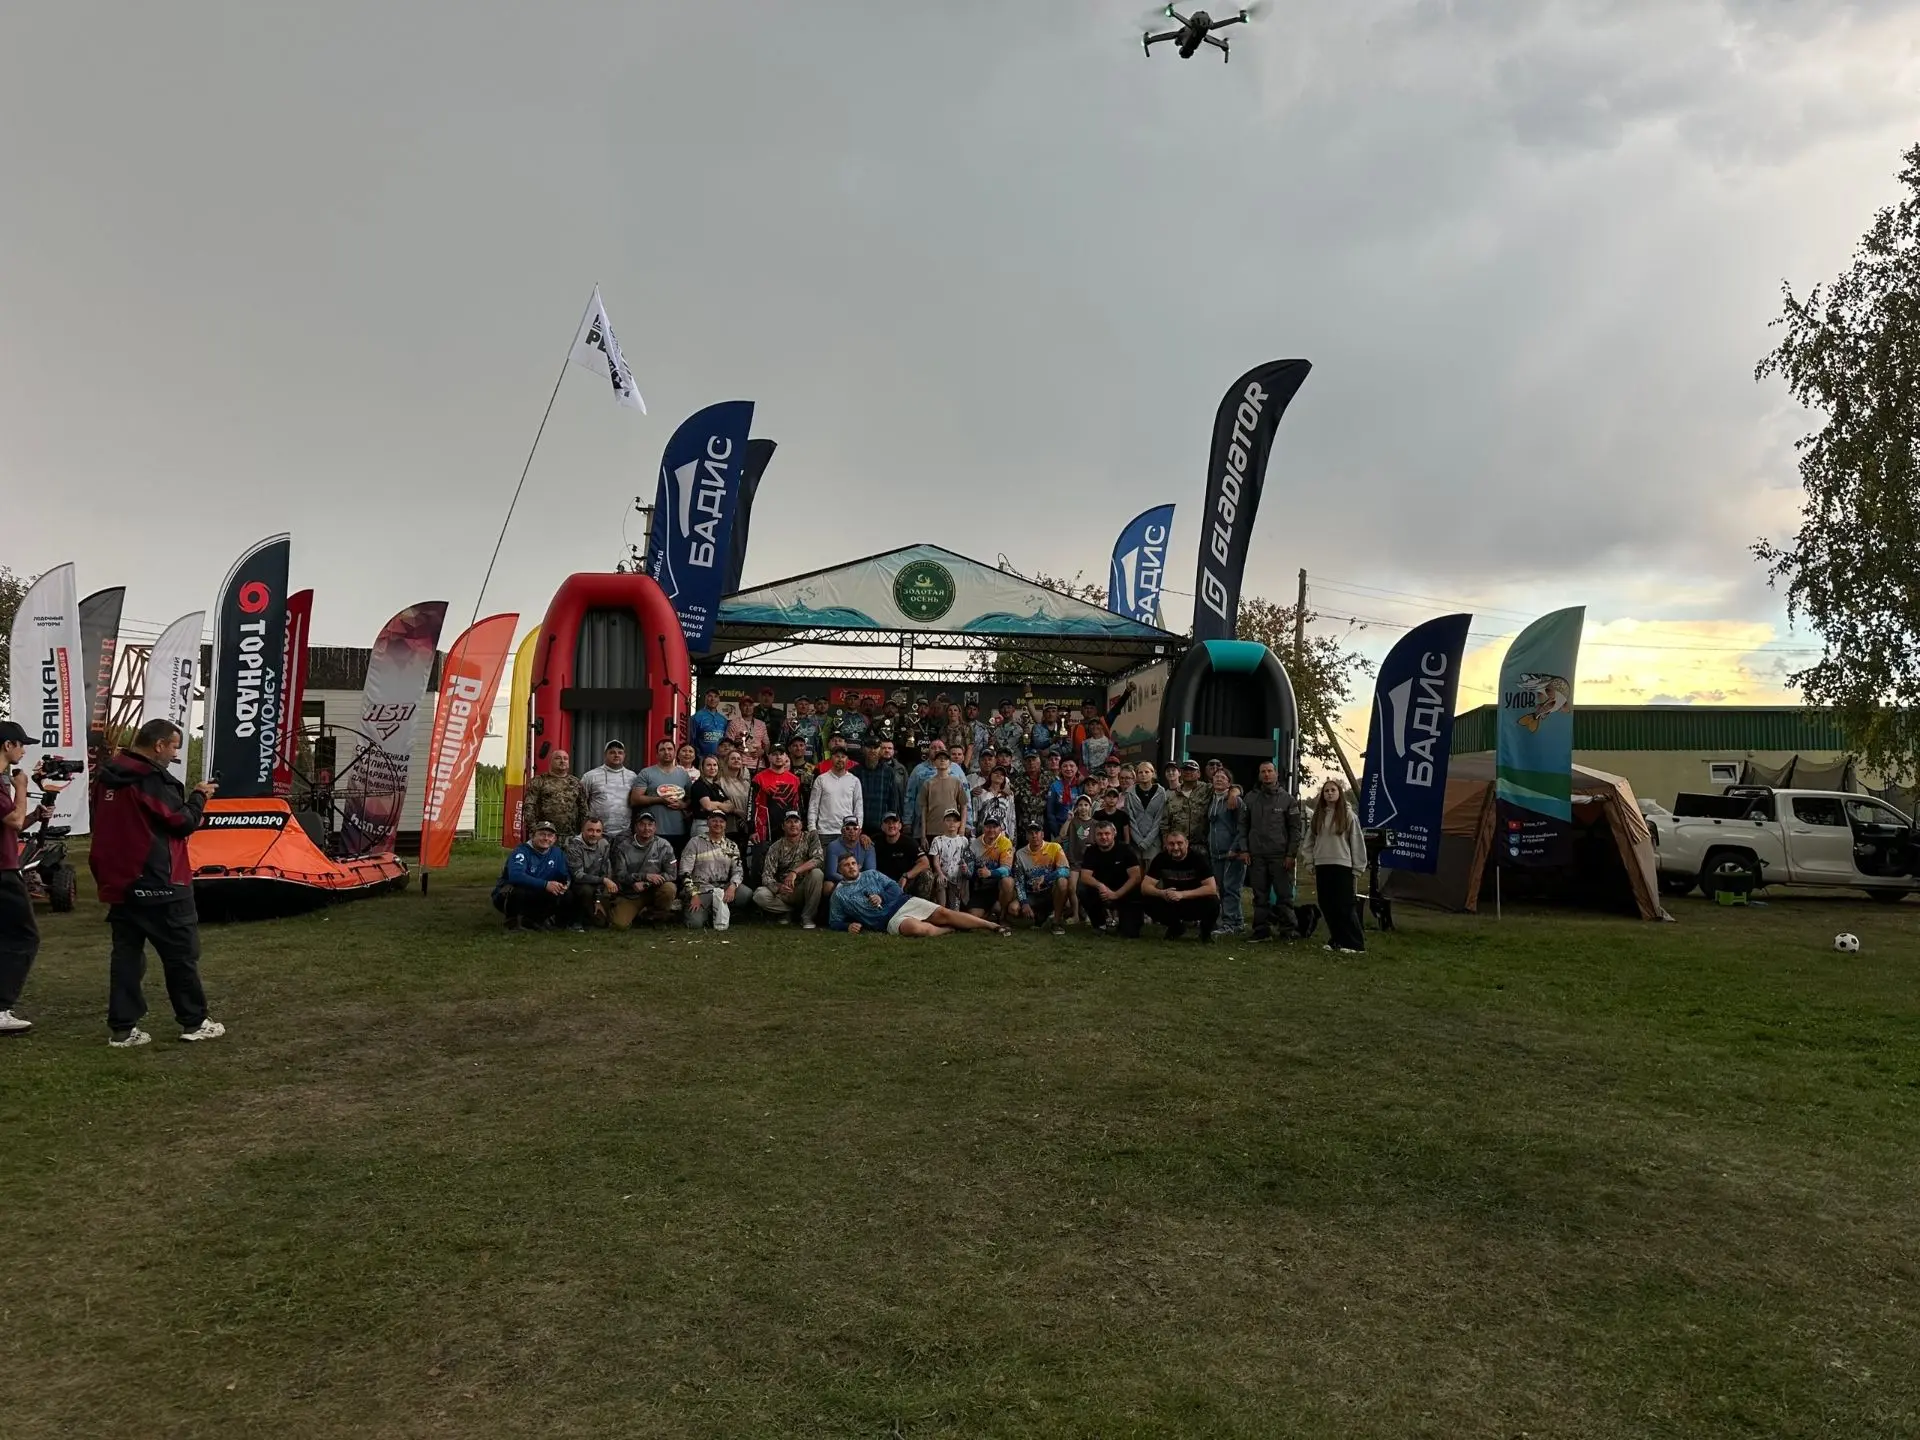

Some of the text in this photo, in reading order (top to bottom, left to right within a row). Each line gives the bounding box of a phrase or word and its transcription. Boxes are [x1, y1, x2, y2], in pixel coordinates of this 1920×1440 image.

[688, 435, 732, 569] БАДИС
[689, 605, 706, 613] сеть
[42, 648, 59, 747] BAIKAL
[59, 651, 72, 743] POWERFUL TECHNOLOGIES
[90, 638, 115, 732] HUNTER
[169, 656, 180, 709] КОМПАНИЙ
[234, 619, 266, 738] ТОРНАДО
[1505, 691, 1536, 708] УЛОВ
[355, 744, 409, 761] СОРЕМЕННАЯ
[424, 675, 482, 821] Remington
[1405, 651, 1448, 788] БАДИС
[208, 815, 283, 826] ТОРНАДОАЭРО
[1367, 773, 1379, 823] ooo-badis.ru
[1410, 825, 1428, 833] сеть
